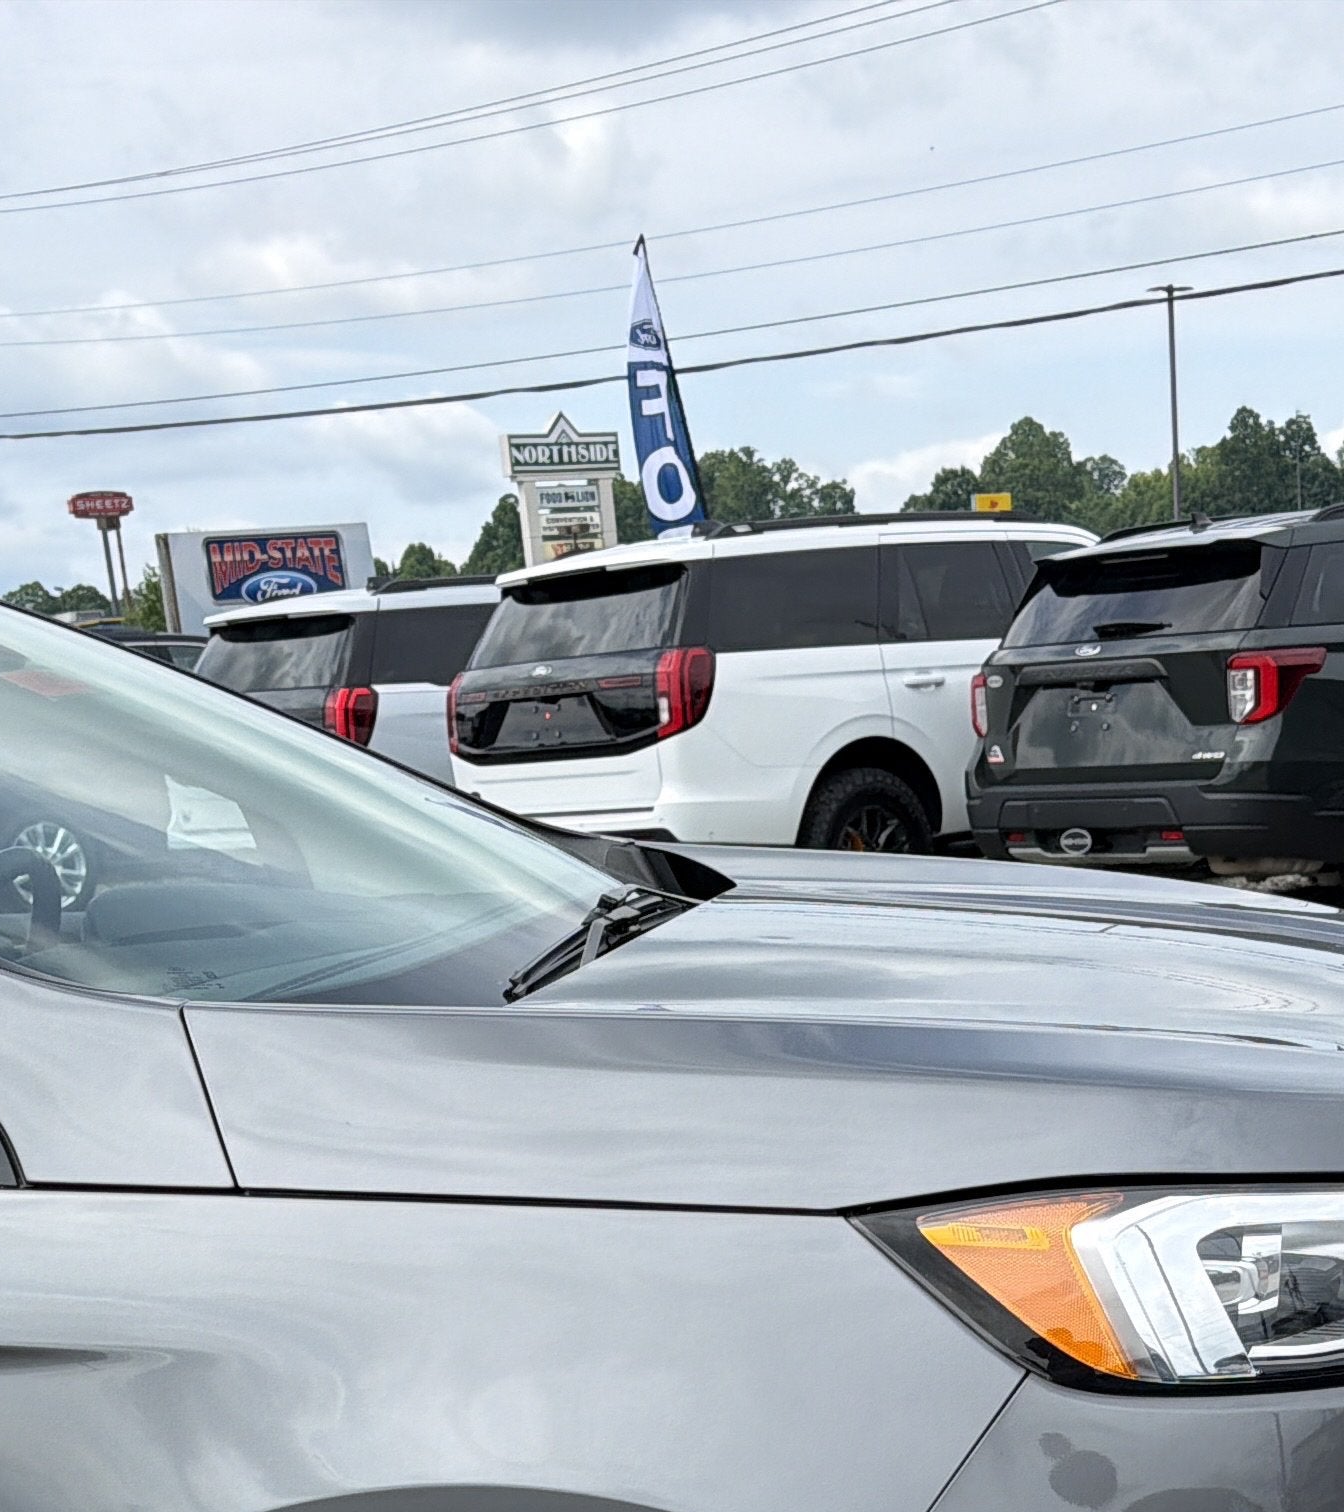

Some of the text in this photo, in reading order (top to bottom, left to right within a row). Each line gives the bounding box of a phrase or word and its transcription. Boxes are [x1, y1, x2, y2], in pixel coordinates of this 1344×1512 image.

[510, 443, 619, 464] NORTHSIDE
[76, 497, 131, 511] SHEETZ
[208, 536, 343, 595] MID-STATE
[256, 576, 303, 602] Ford
